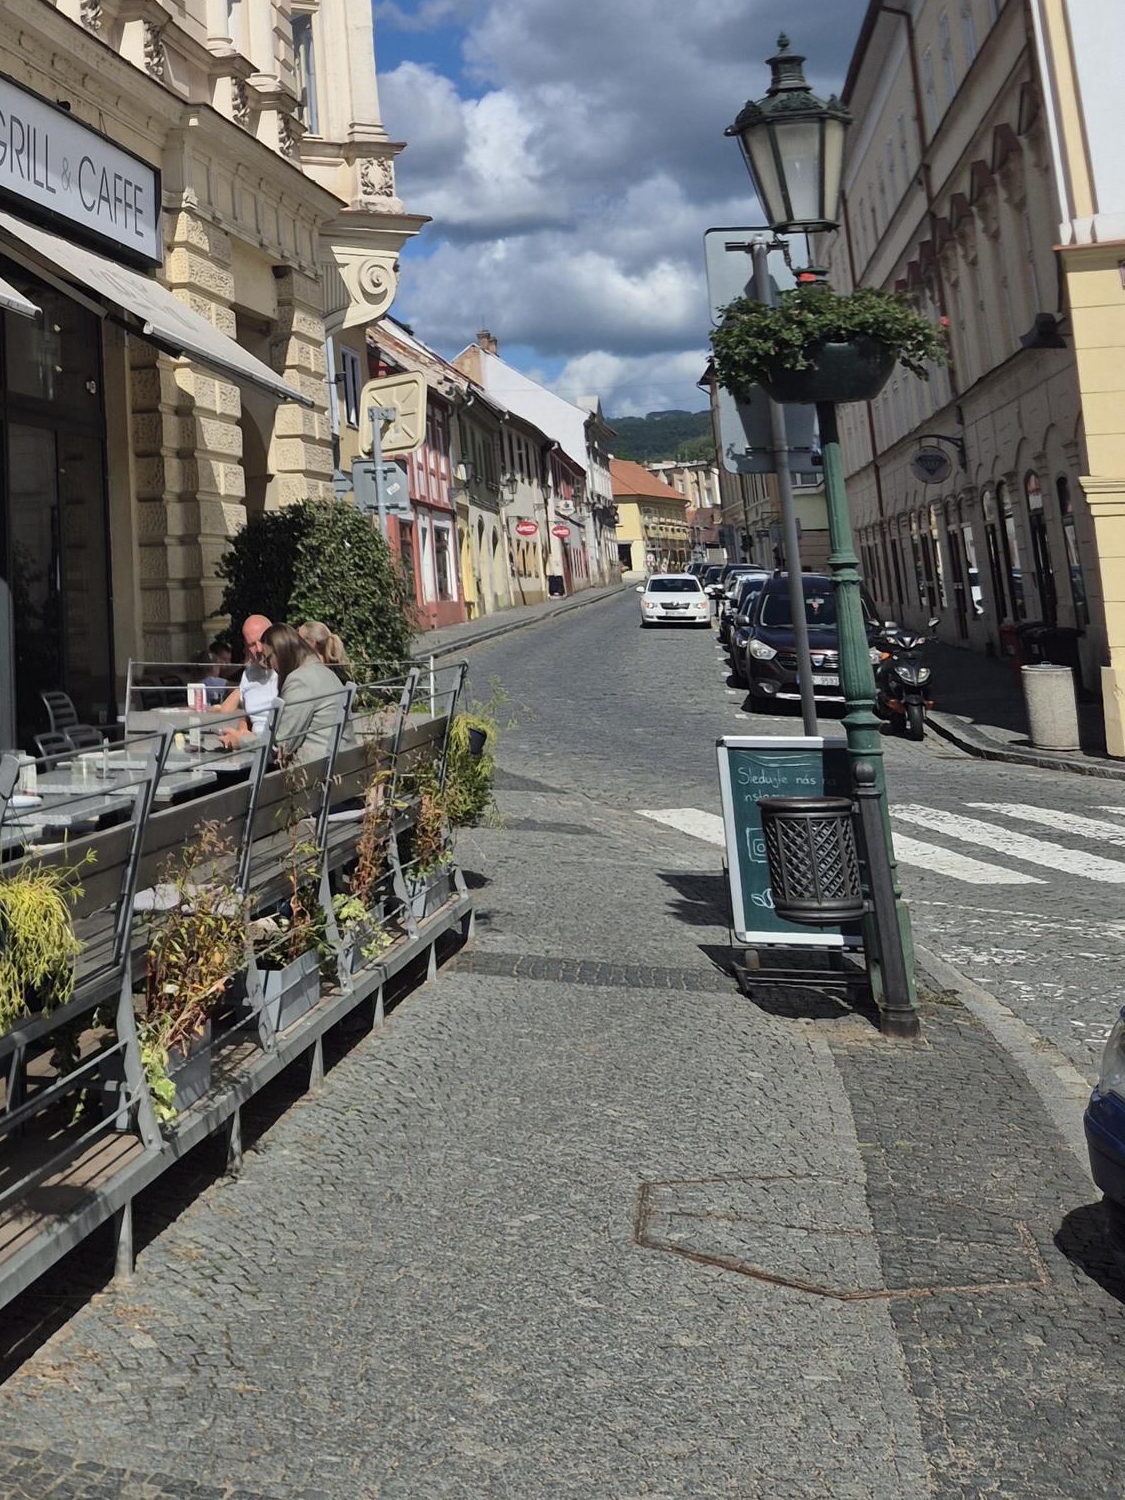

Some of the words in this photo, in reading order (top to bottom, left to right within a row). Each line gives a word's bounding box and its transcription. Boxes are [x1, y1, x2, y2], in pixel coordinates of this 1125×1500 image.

[61, 156, 75, 193] &
[78, 155, 145, 238] CAFFE
[795, 772, 817, 785] nás
